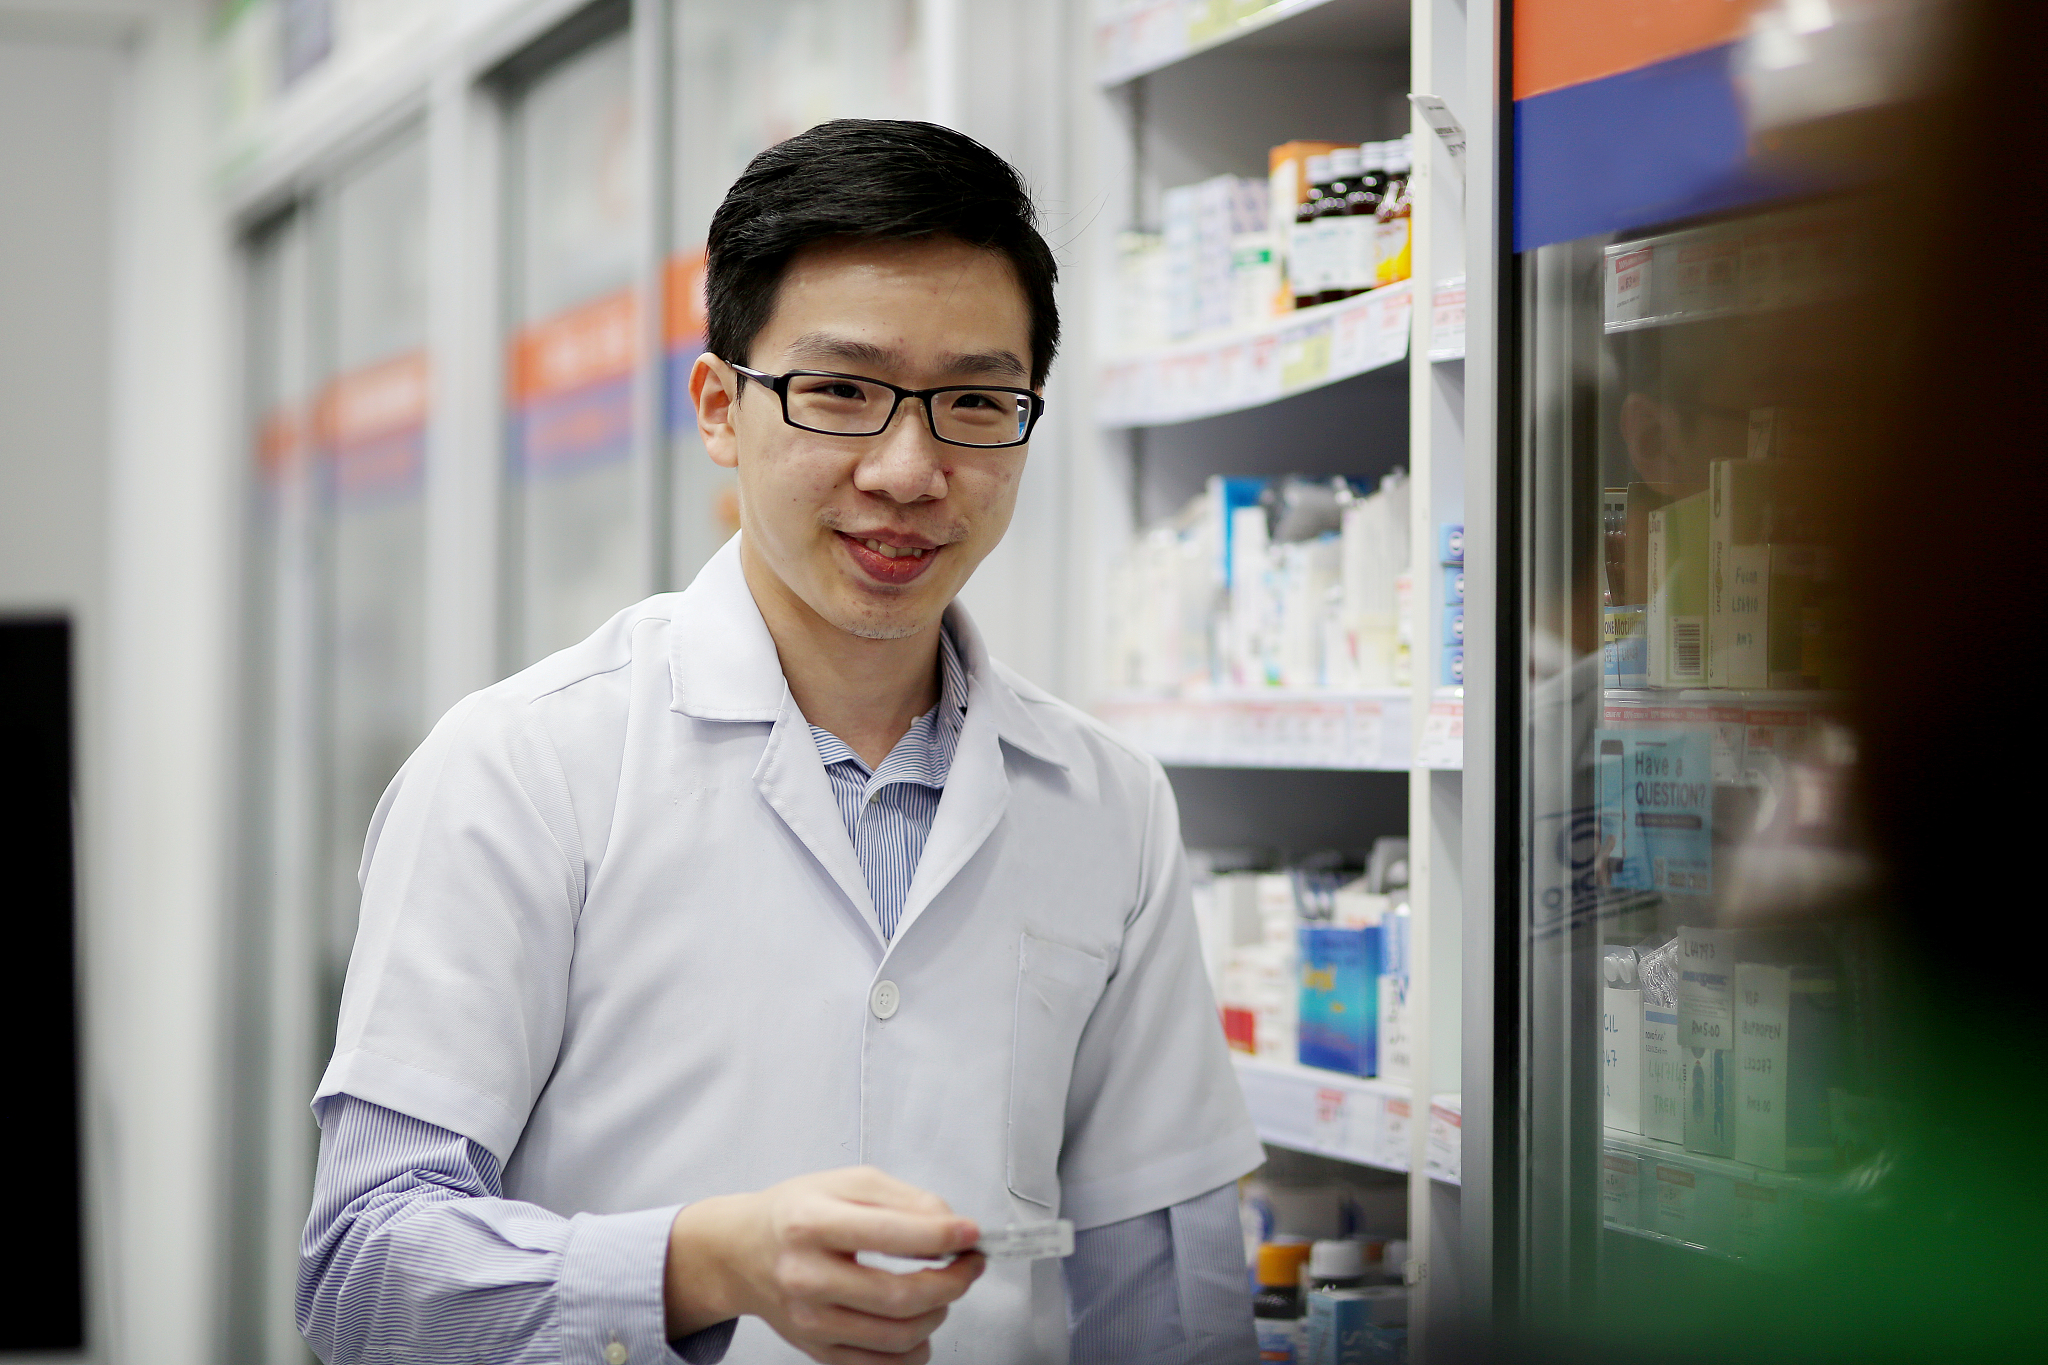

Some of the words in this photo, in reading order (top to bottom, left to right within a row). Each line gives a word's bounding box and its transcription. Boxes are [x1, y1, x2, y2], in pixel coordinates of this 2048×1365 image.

[1615, 617, 1646, 635] Motilium
[1635, 751, 1669, 777] Have
[1675, 757, 1683, 778] a
[1635, 782, 1706, 807] QUESTION?
